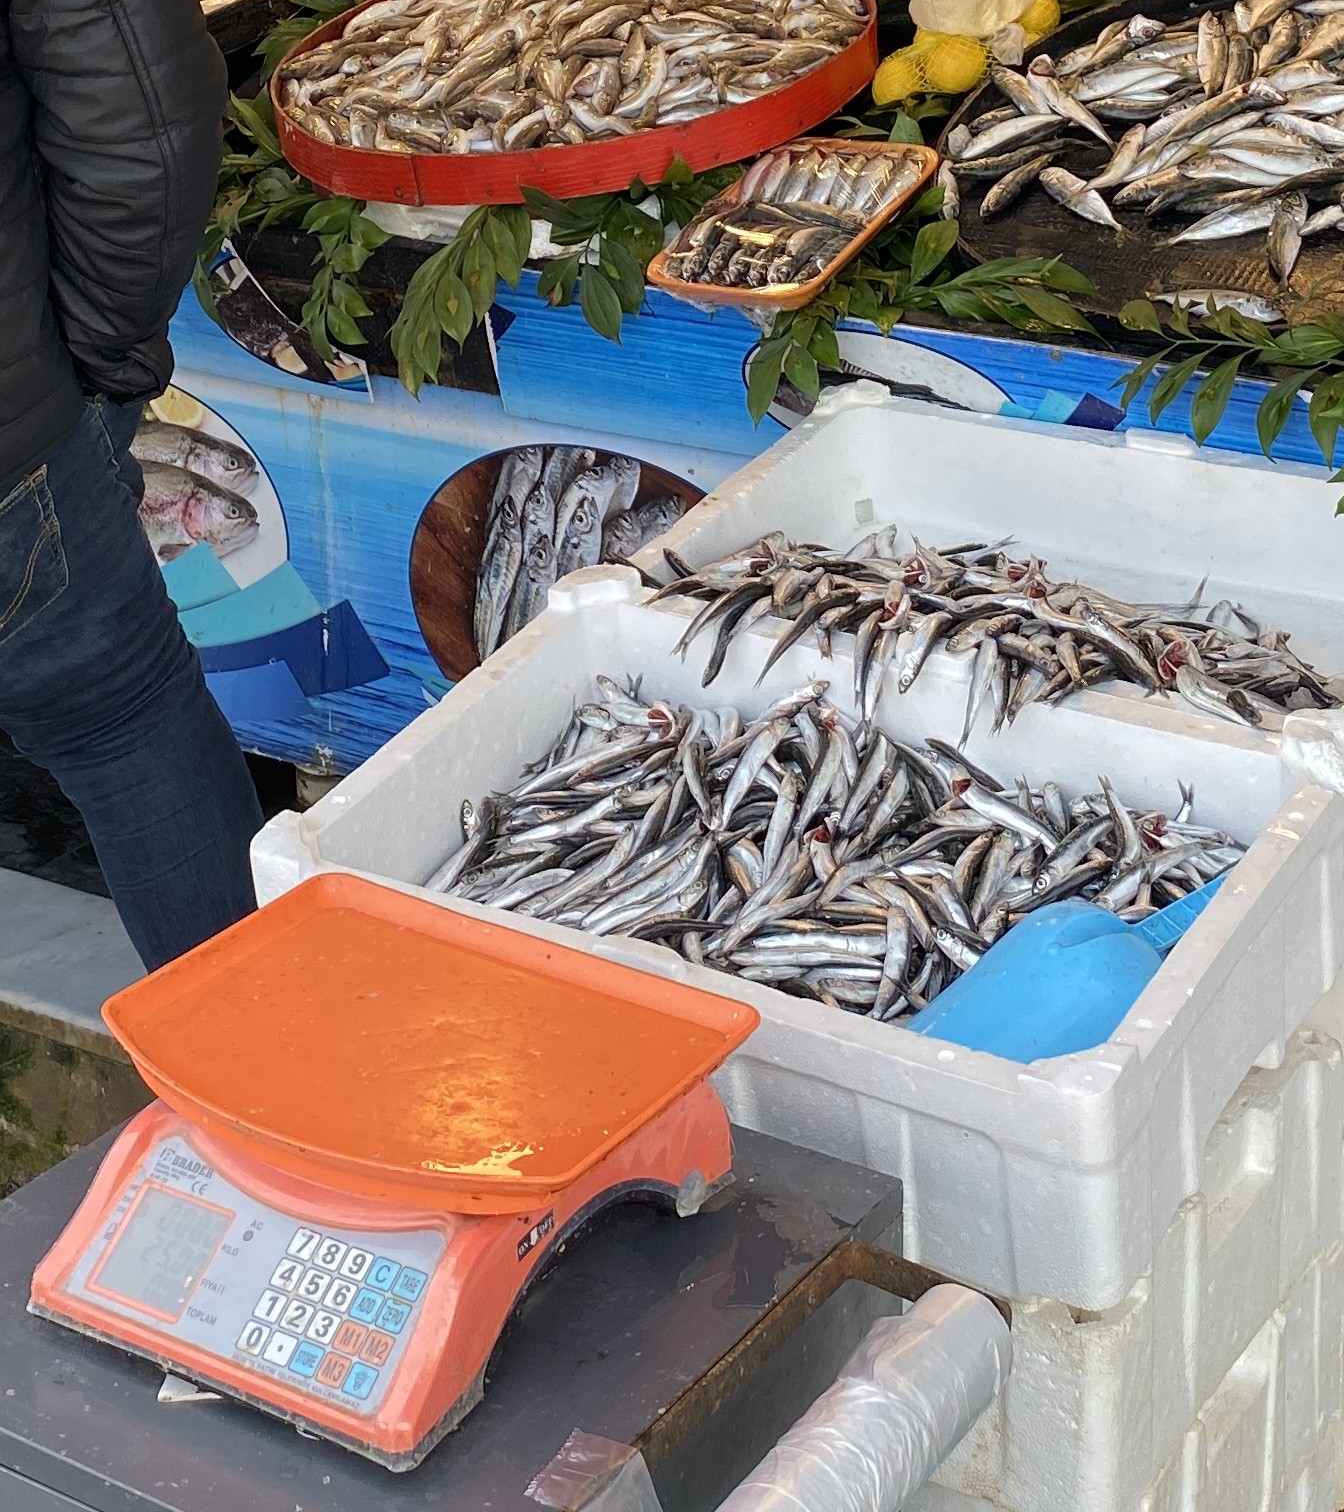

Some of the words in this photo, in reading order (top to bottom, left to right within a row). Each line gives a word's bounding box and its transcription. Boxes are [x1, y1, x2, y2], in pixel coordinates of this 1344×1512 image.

[249, 1219, 265, 1231] AC
[296, 1233, 315, 1254] 7
[321, 1243, 340, 1265] 8
[348, 1253, 367, 1275] 9
[375, 1264, 391, 1284] C
[278, 1265, 297, 1285] 4
[304, 1273, 325, 1296] 5
[332, 1283, 351, 1307] 6
[186, 1306, 218, 1326] TOPLAM
[265, 1296, 280, 1317] 1
[286, 1305, 308, 1329] 2
[315, 1315, 334, 1338] 3
[339, 1327, 362, 1350] M1
[366, 1337, 389, 1361] M2
[246, 1326, 263, 1348] 0
[321, 1358, 345, 1382] M3
